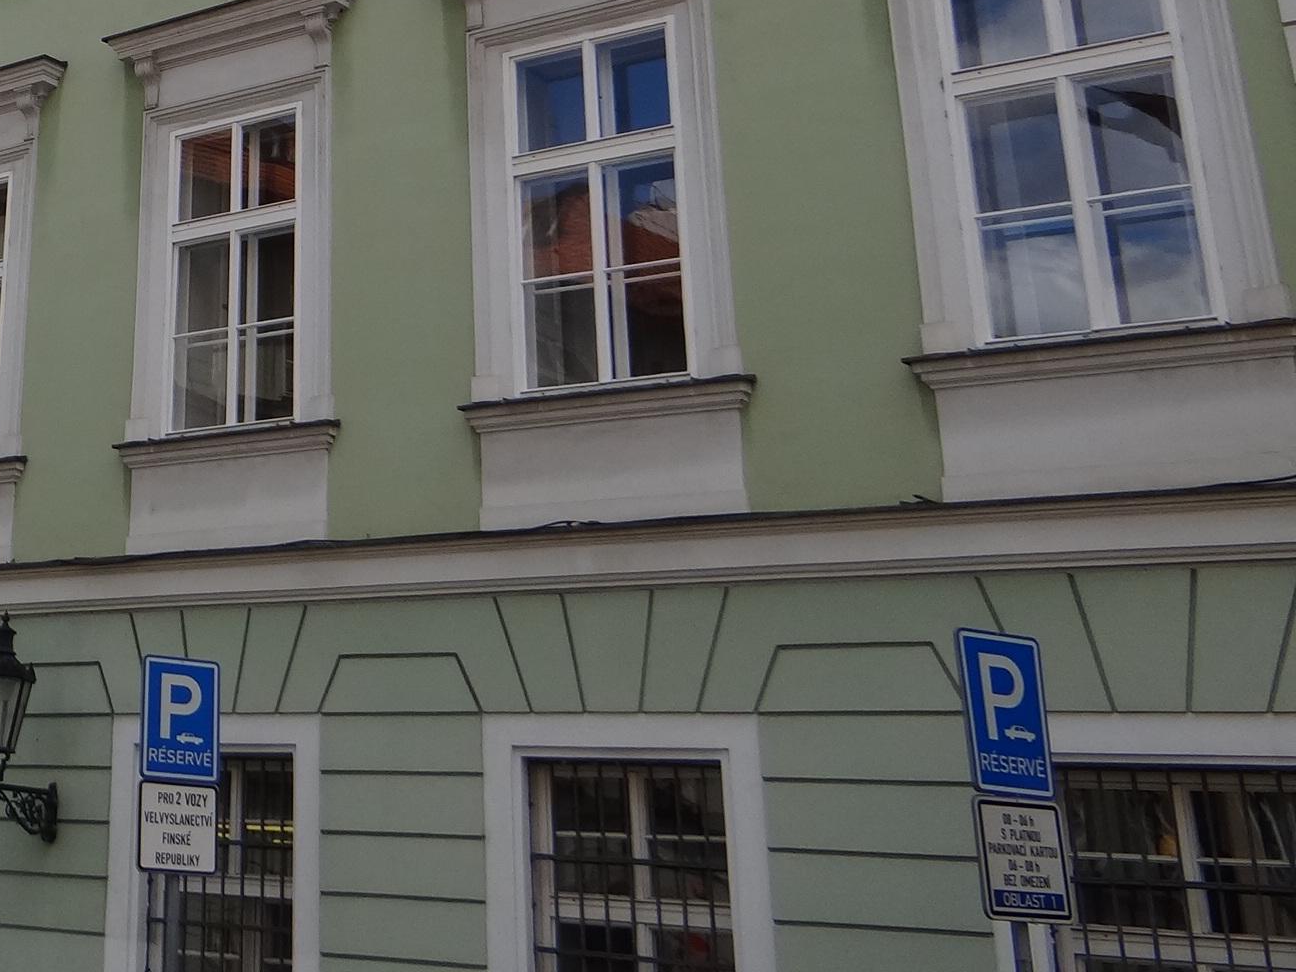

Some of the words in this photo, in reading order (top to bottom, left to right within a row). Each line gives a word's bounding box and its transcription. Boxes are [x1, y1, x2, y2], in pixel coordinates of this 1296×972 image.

[978, 652, 1025, 740] P
[160, 672, 202, 739] P
[148, 745, 213, 768] RÉSERVÉ
[979, 750, 1047, 778] RÉSERVÉ
[157, 791, 174, 804] PRO
[176, 791, 182, 805] 2
[184, 792, 208, 808] VOZY
[144, 810, 214, 827] VELVYSLANECTVÍ
[162, 831, 192, 846] FINSKÉ
[1000, 828, 1007, 840] S
[1009, 829, 1041, 843] PLATNOU
[155, 851, 200, 866] REPUBLIKY
[1030, 845, 1058, 859] KARTOU
[1003, 873, 1017, 886] BEZ
[1020, 874, 1051, 889] OMEZENÍ
[1003, 892, 1046, 908] OBLAST
[1051, 894, 1057, 909] 1
